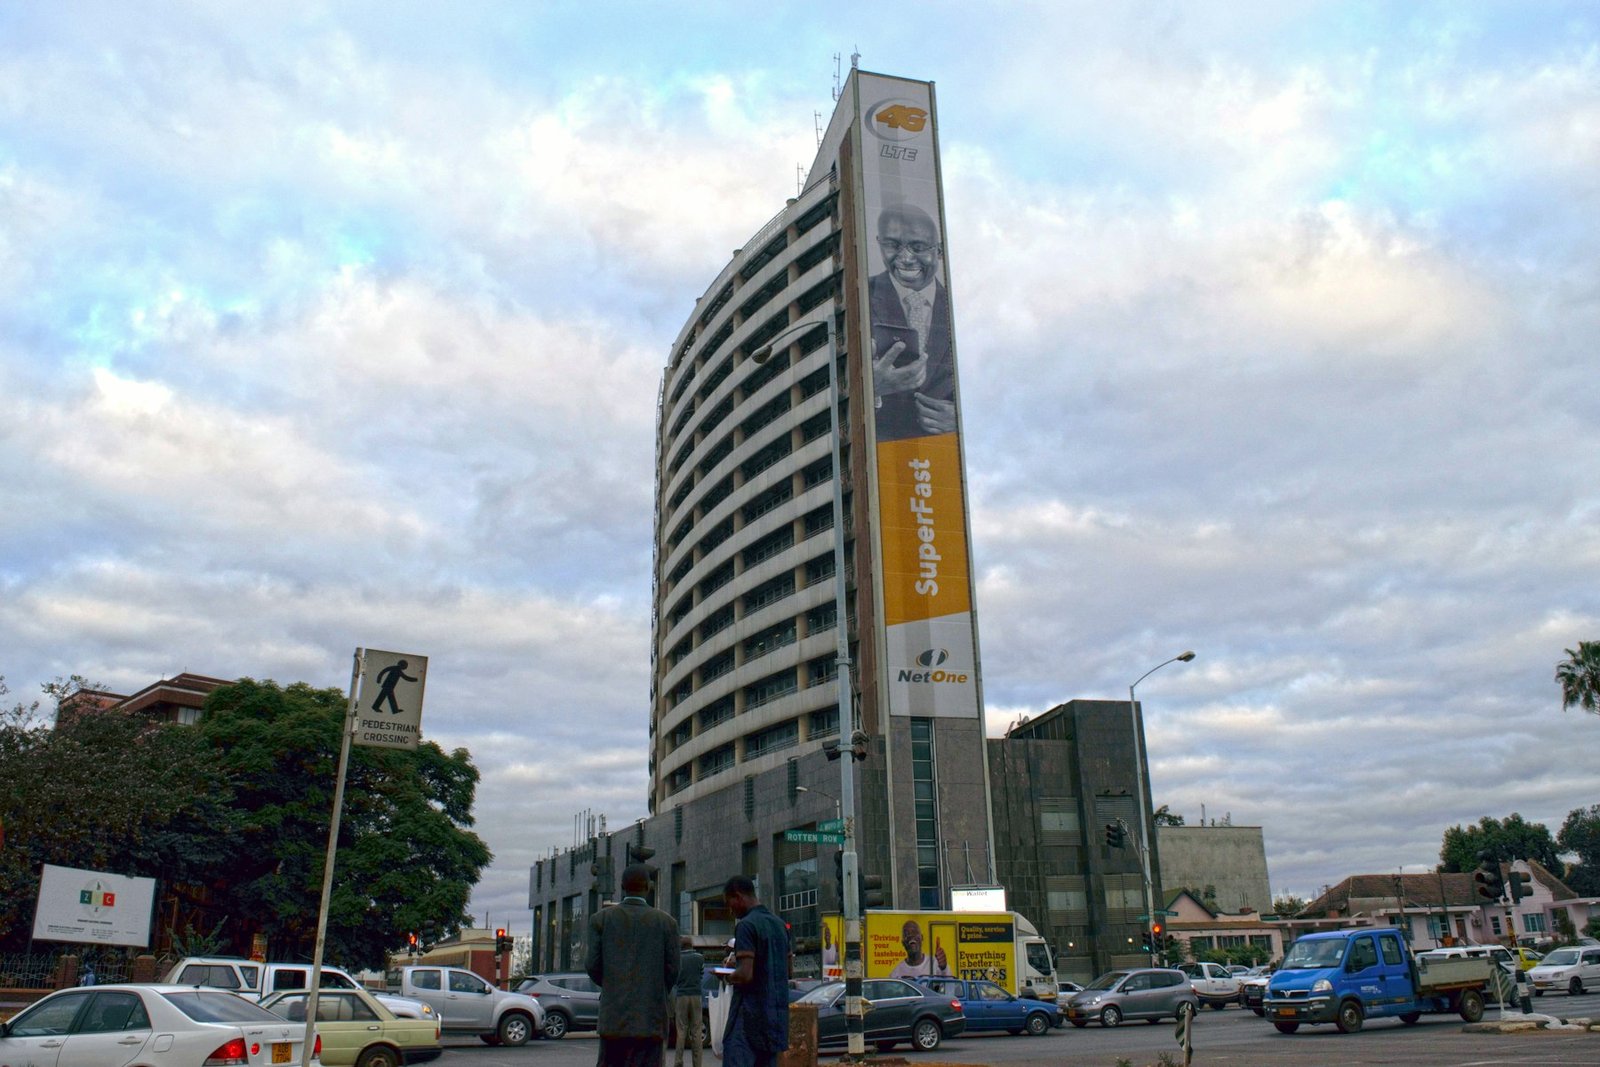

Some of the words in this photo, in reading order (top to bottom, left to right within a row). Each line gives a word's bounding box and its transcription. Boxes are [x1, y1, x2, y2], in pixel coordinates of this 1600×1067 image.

[875, 104, 929, 132] 4G
[880, 144, 918, 161] LTE
[908, 458, 941, 596] SuperFast
[897, 669, 968, 683] NetOne
[362, 719, 417, 733] PEDESTRIAN
[787, 832, 818, 842] ROTTEN
[959, 950, 1007, 960] Everything
[967, 959, 993, 968] better
